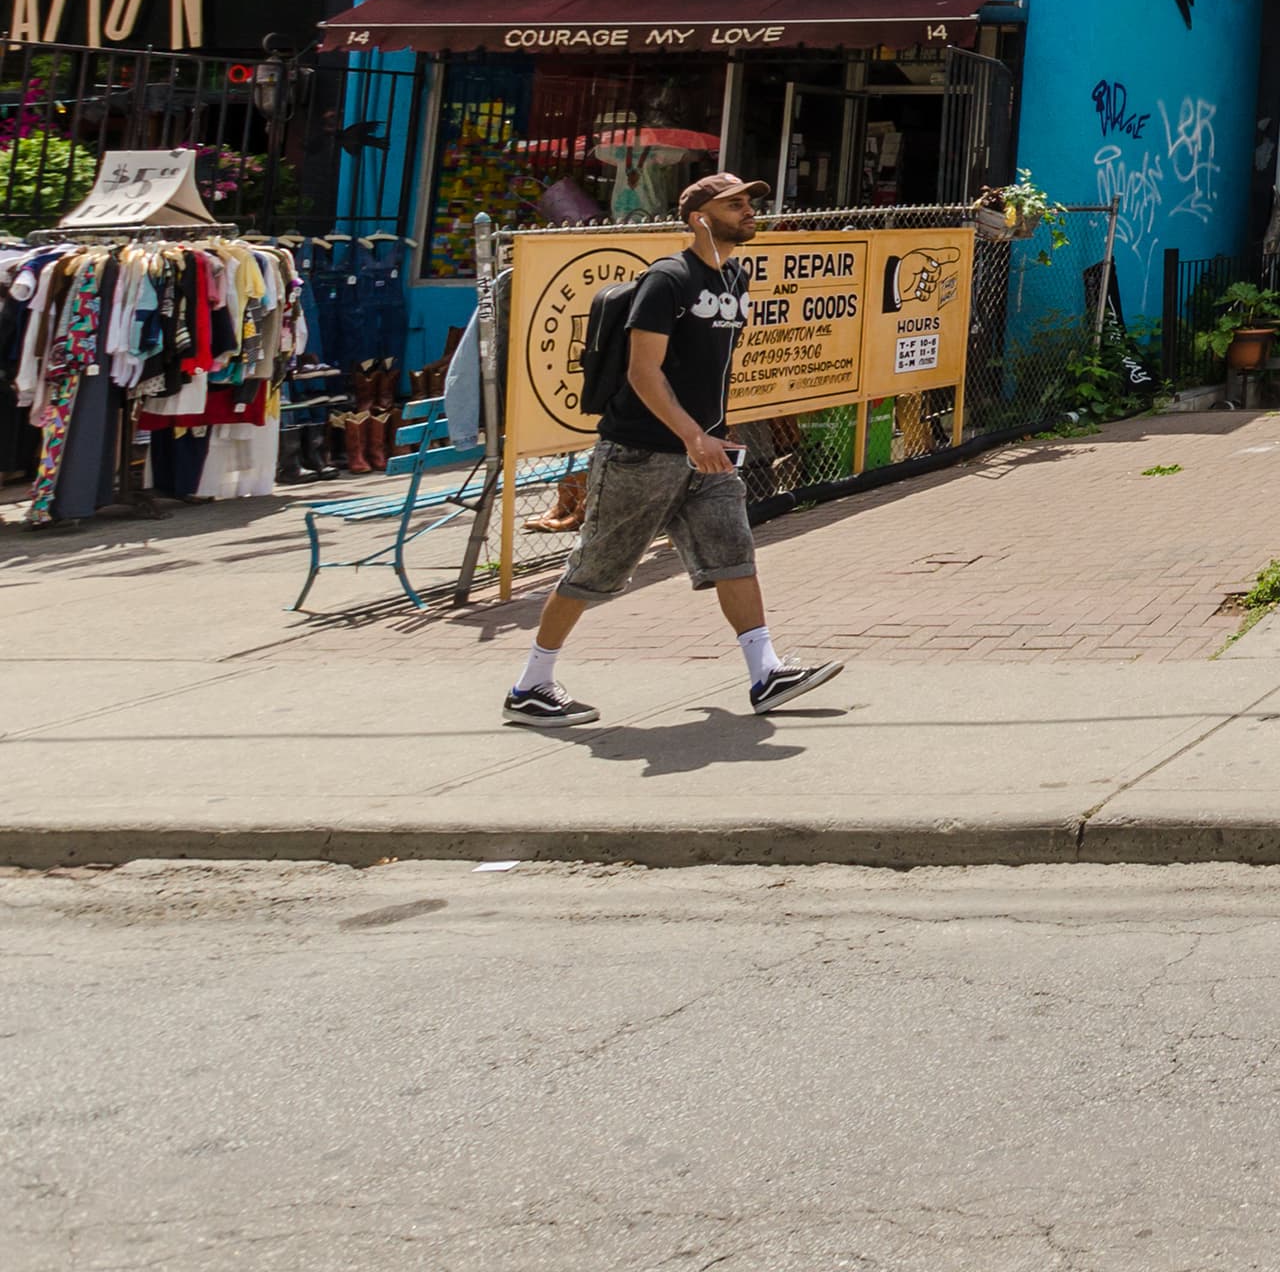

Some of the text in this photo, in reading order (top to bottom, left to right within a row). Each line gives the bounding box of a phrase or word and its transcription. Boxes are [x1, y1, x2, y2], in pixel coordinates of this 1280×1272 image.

[347, 30, 370, 45] 14
[504, 26, 786, 47] COURAGE MY LOVE
[926, 24, 949, 41] 14
[784, 253, 855, 279] REPAIR
[772, 284, 798, 295] AND
[541, 284, 576, 352] SOLE
[748, 299, 789, 327] HER
[802, 294, 858, 321] GOODS
[897, 317, 940, 333] HOURS
[747, 326, 816, 347] KENSINGTON
[816, 324, 832, 336] AVE
[898, 350, 915, 359] SAT
